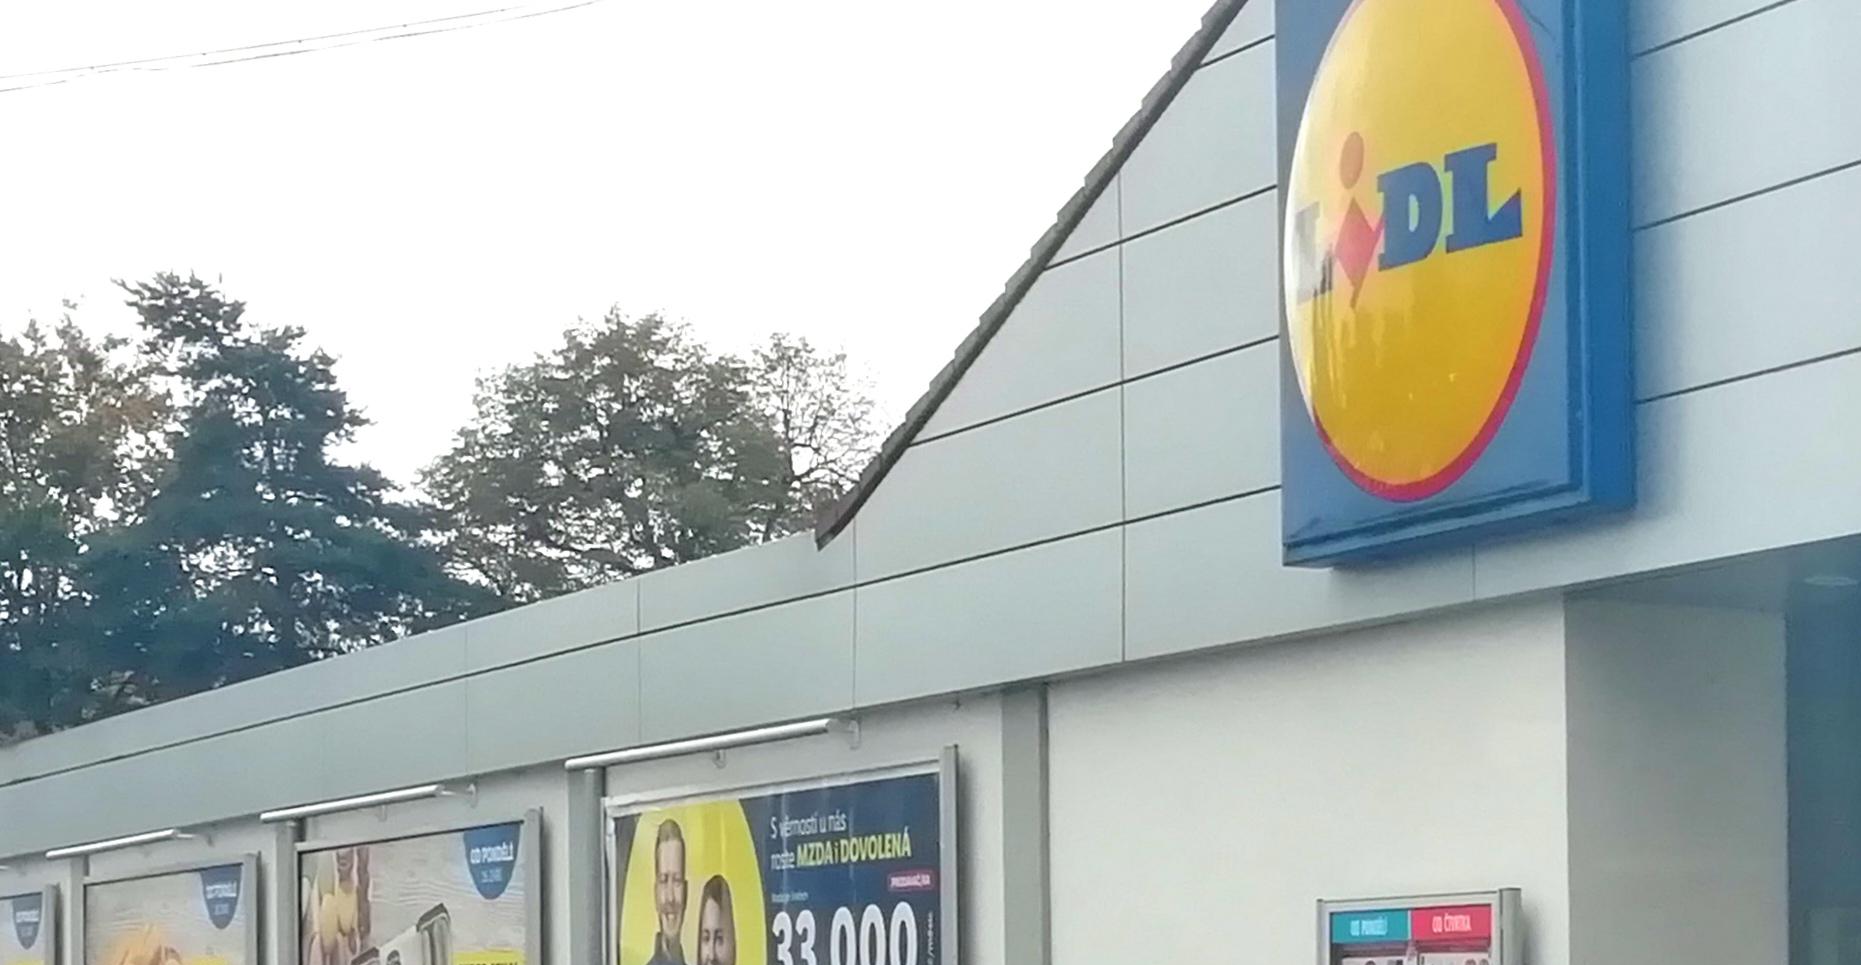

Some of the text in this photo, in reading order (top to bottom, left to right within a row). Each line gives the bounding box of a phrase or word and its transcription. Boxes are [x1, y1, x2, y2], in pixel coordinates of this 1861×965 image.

[770, 816, 778, 839] S
[819, 817, 827, 833] u
[828, 809, 847, 831] nás
[797, 841, 834, 867] MZDA
[834, 840, 839, 863] i
[840, 826, 912, 862] DOVOLENÁ
[1432, 915, 1443, 933] OD
